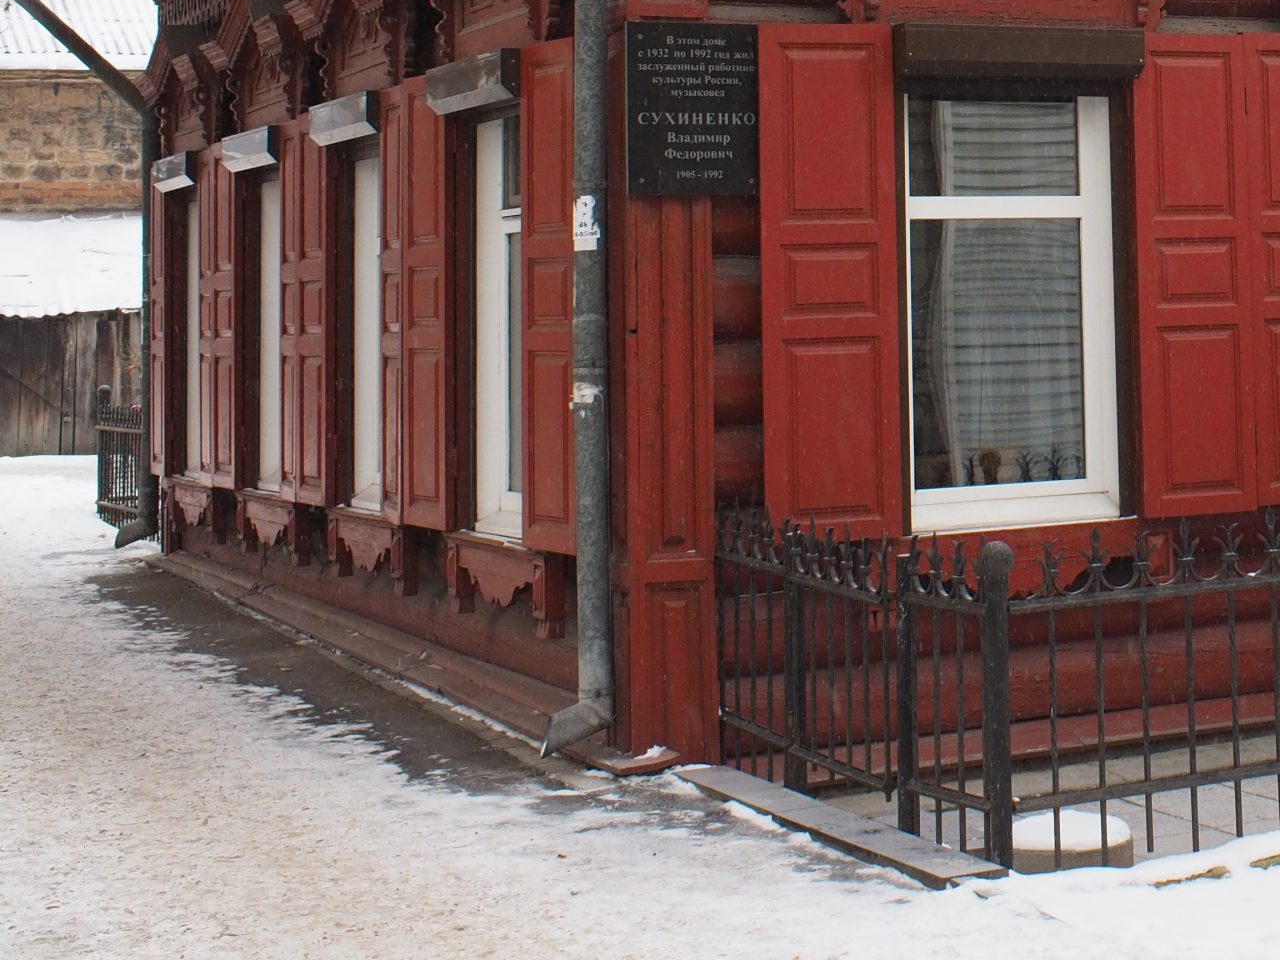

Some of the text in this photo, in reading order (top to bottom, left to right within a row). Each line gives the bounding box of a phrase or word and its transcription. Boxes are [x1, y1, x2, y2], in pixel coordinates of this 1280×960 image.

[666, 36, 727, 46] В этом доме
[638, 48, 754, 60] с 1932 по 1992 год жил
[637, 62, 755, 74] заслуженный работник
[652, 75, 742, 86] культуры России,
[671, 89, 725, 99] музыковед
[637, 112, 756, 126] СУХИНЕНКО
[667, 131, 731, 146] Владимир
[664, 148, 733, 162] Федорович
[676, 170, 696, 179] 1905
[704, 170, 724, 179] 1992
